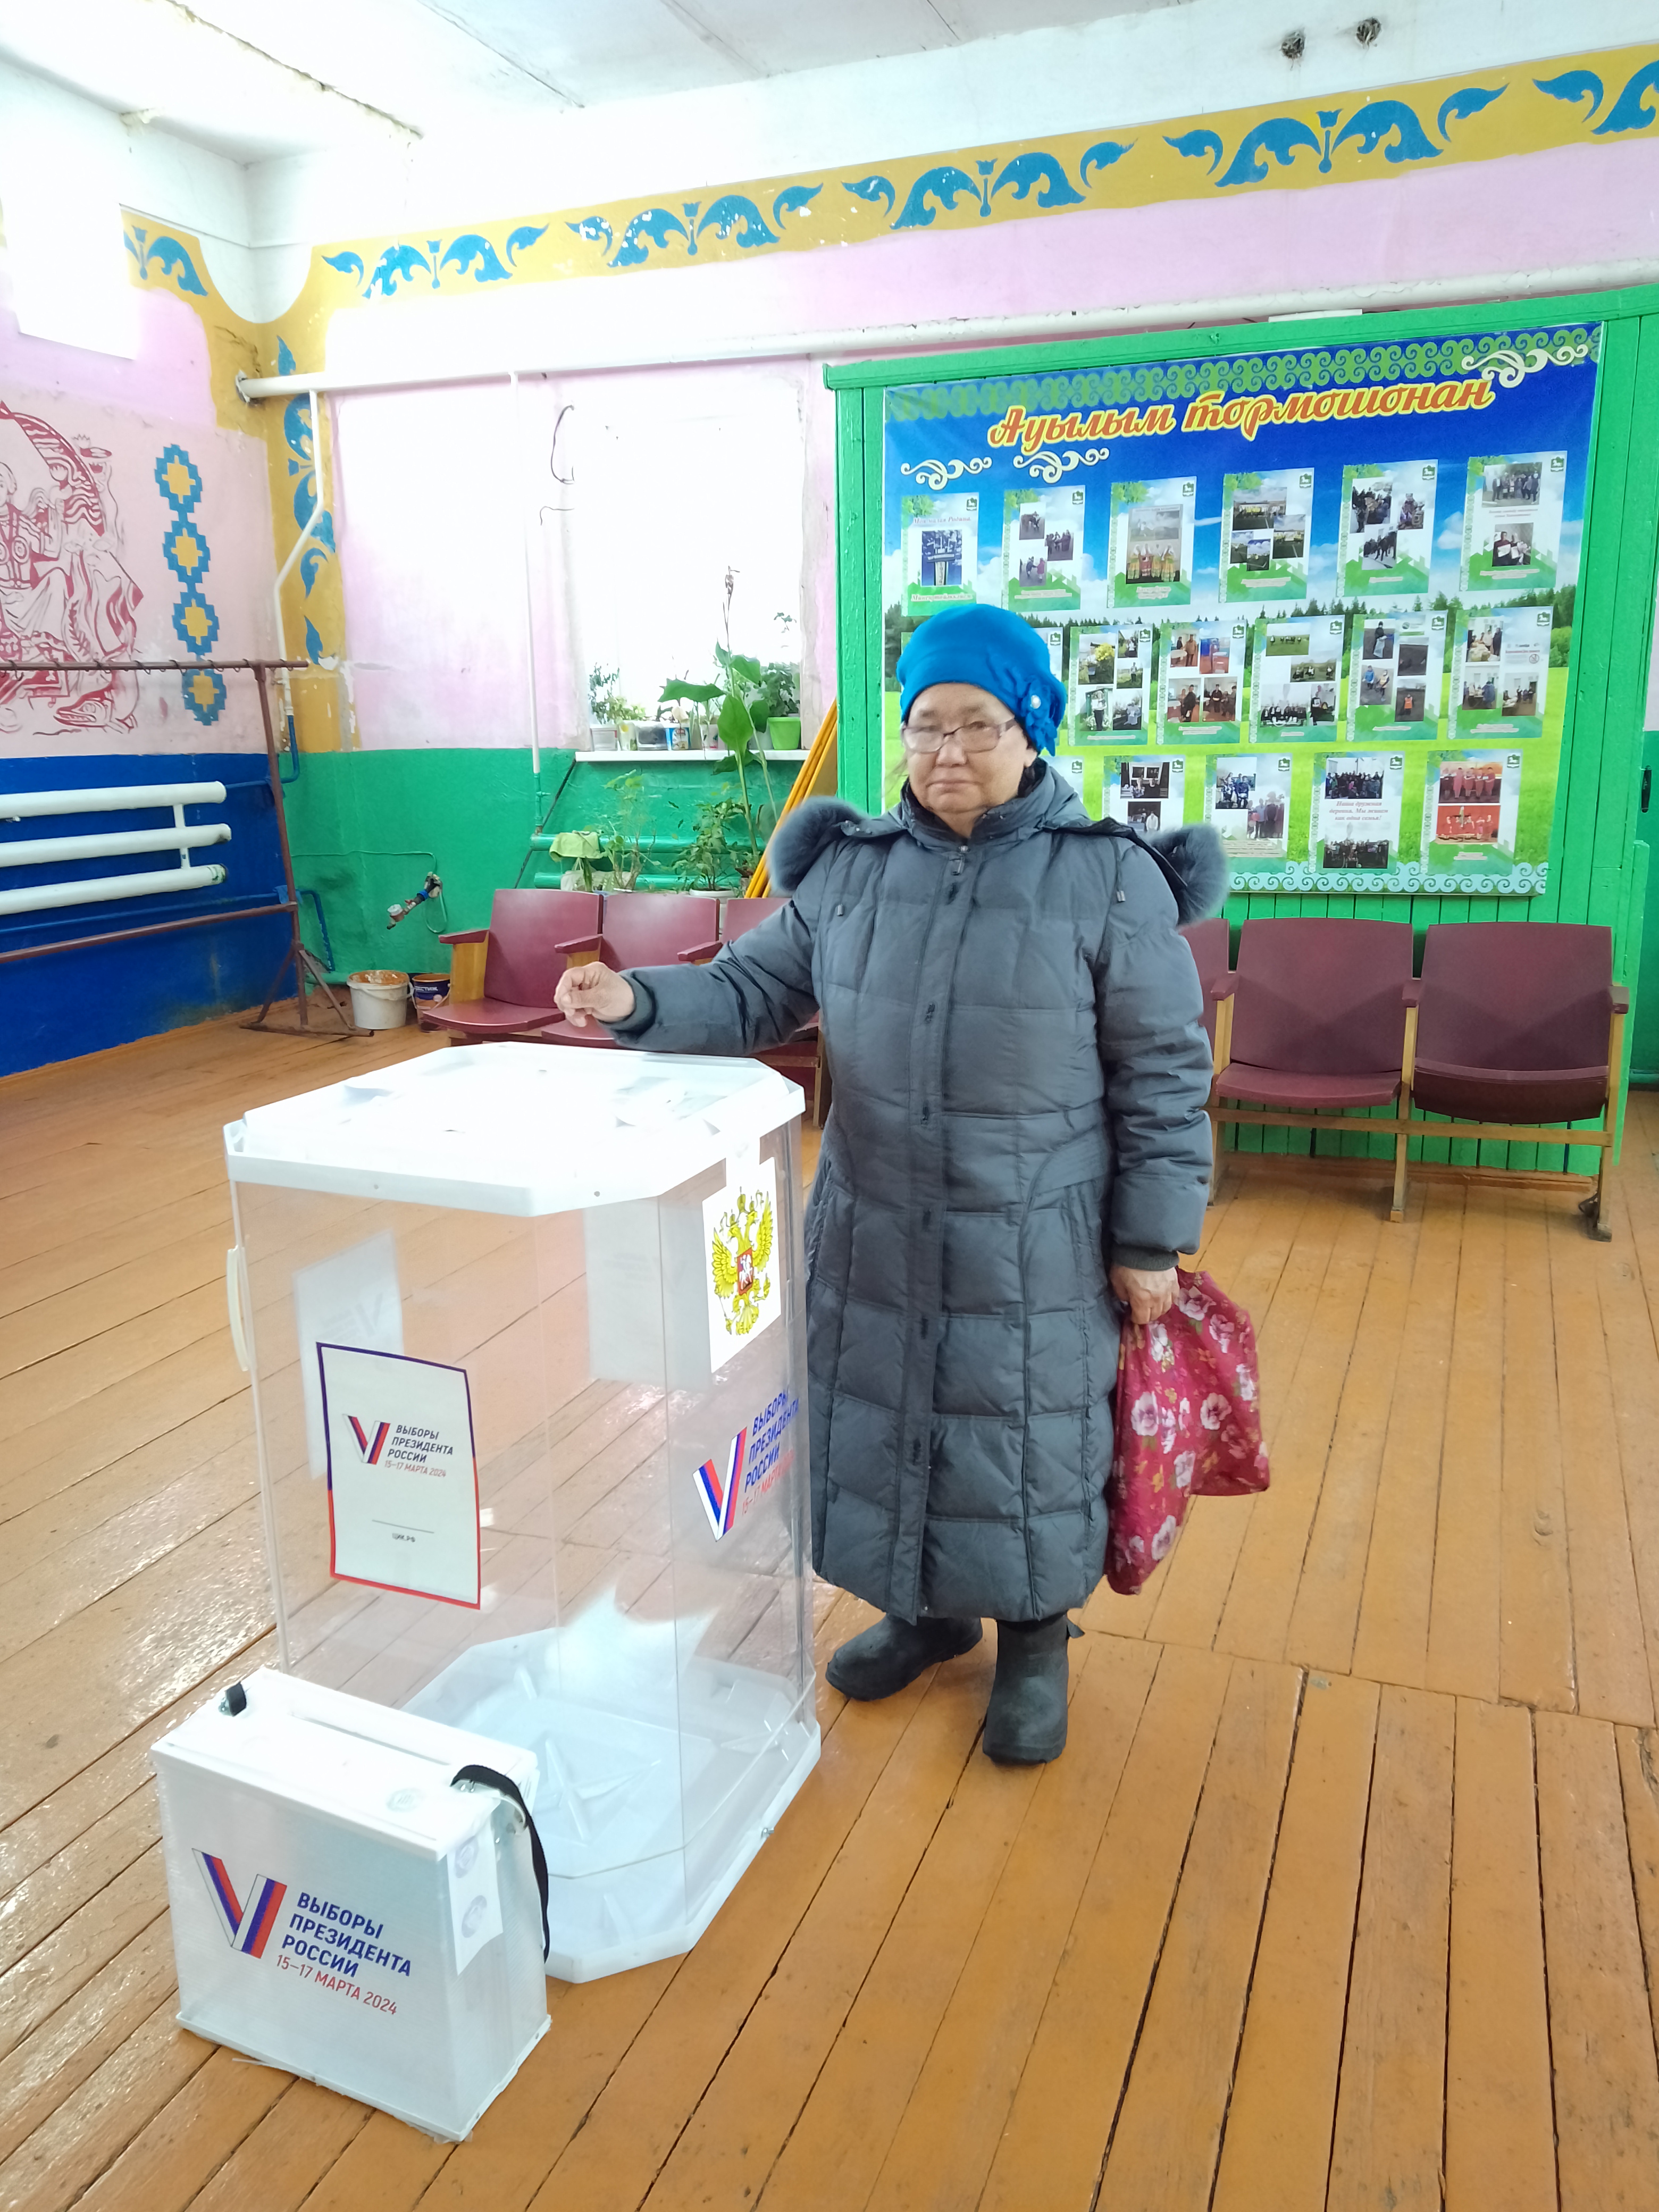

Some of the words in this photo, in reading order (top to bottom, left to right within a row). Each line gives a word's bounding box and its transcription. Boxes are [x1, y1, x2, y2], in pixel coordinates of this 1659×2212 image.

[987, 405, 1175, 454] Ауылым
[1182, 379, 1496, 441] тормошонан
[396, 1425, 439, 1440] ВЫБОРЫ
[752, 1385, 789, 1437] ВЫБОРЫ
[387, 1448, 427, 1463] РОССИИ
[391, 1436, 453, 1455] ПРЕЗИДЕНТА
[744, 1441, 780, 1493] РОССИИ
[404, 1463, 428, 1474] МАРТА
[429, 1468, 446, 1478] 2024
[297, 1892, 383, 1939] ВЫБОРЫ
[281, 1934, 359, 1978] РОССИИ
[289, 1913, 411, 1976] ПРЕЗИДЕНТА
[314, 1970, 361, 2000] МАРТА
[363, 1991, 397, 2015] 2024
